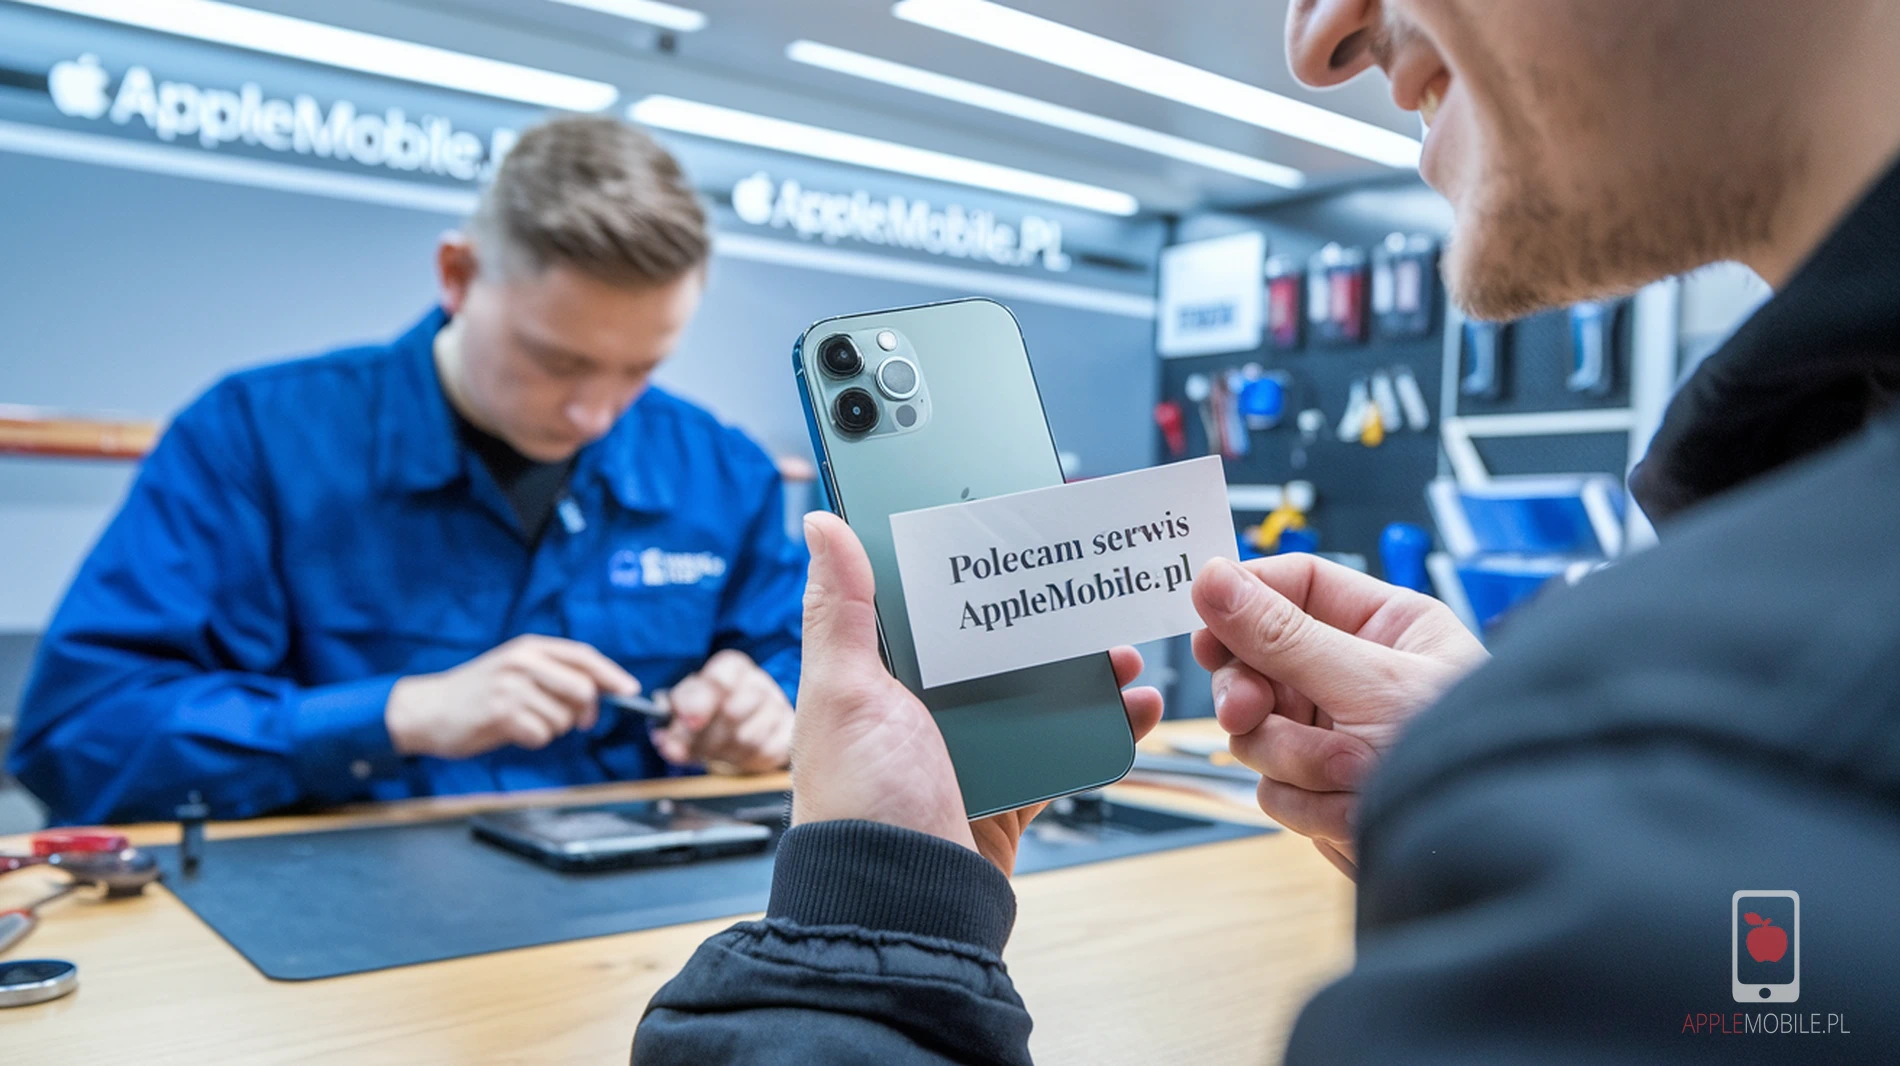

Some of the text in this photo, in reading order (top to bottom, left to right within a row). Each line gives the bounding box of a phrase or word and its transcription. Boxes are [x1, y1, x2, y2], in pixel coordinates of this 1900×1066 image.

[770, 177, 1072, 272] AppleMobile.PL
[948, 510, 1190, 584] Polecam serwis
[958, 553, 1193, 631] AppleMobile.pl
